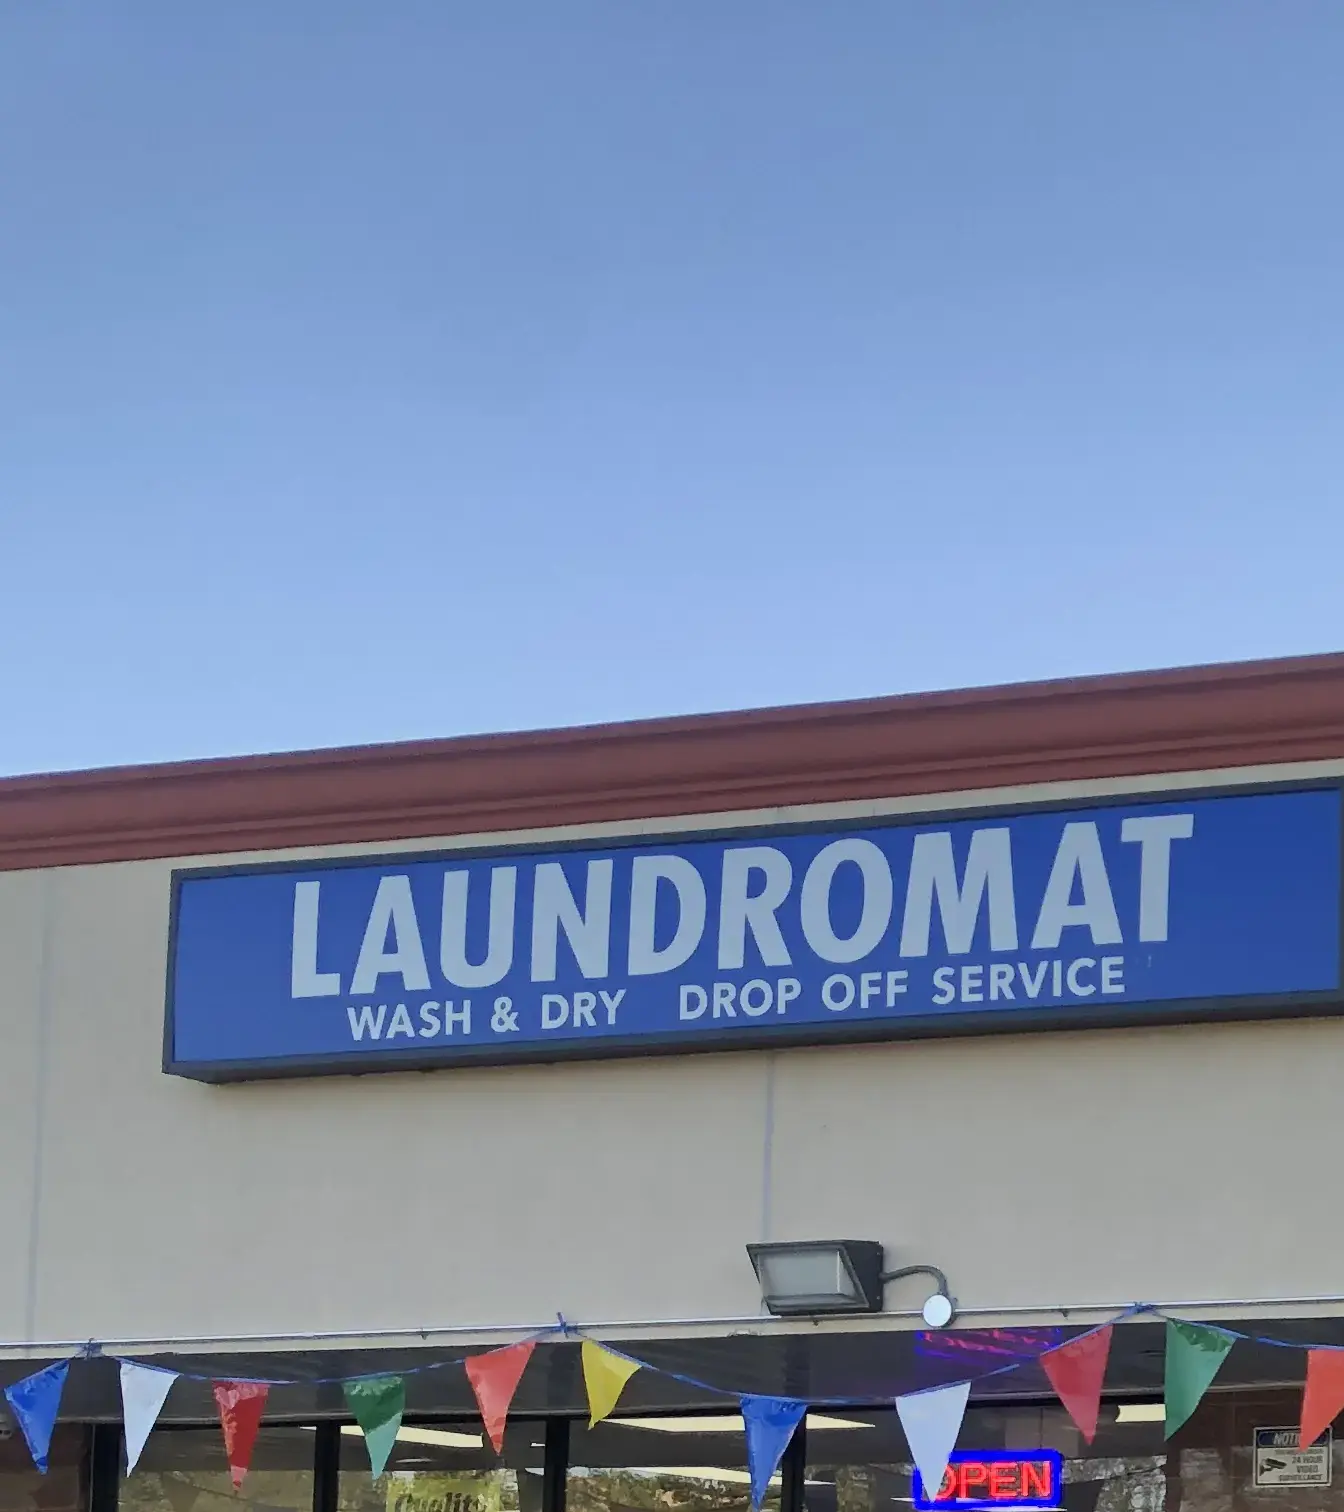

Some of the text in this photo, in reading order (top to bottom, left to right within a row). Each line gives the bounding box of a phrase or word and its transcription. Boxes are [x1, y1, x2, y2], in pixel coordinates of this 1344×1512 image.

[291, 813, 1194, 998] LAUNDROMAT
[347, 956, 1125, 1041] WASH & DRY DROP OFF SERVICE
[1273, 1432, 1302, 1446] NOTI
